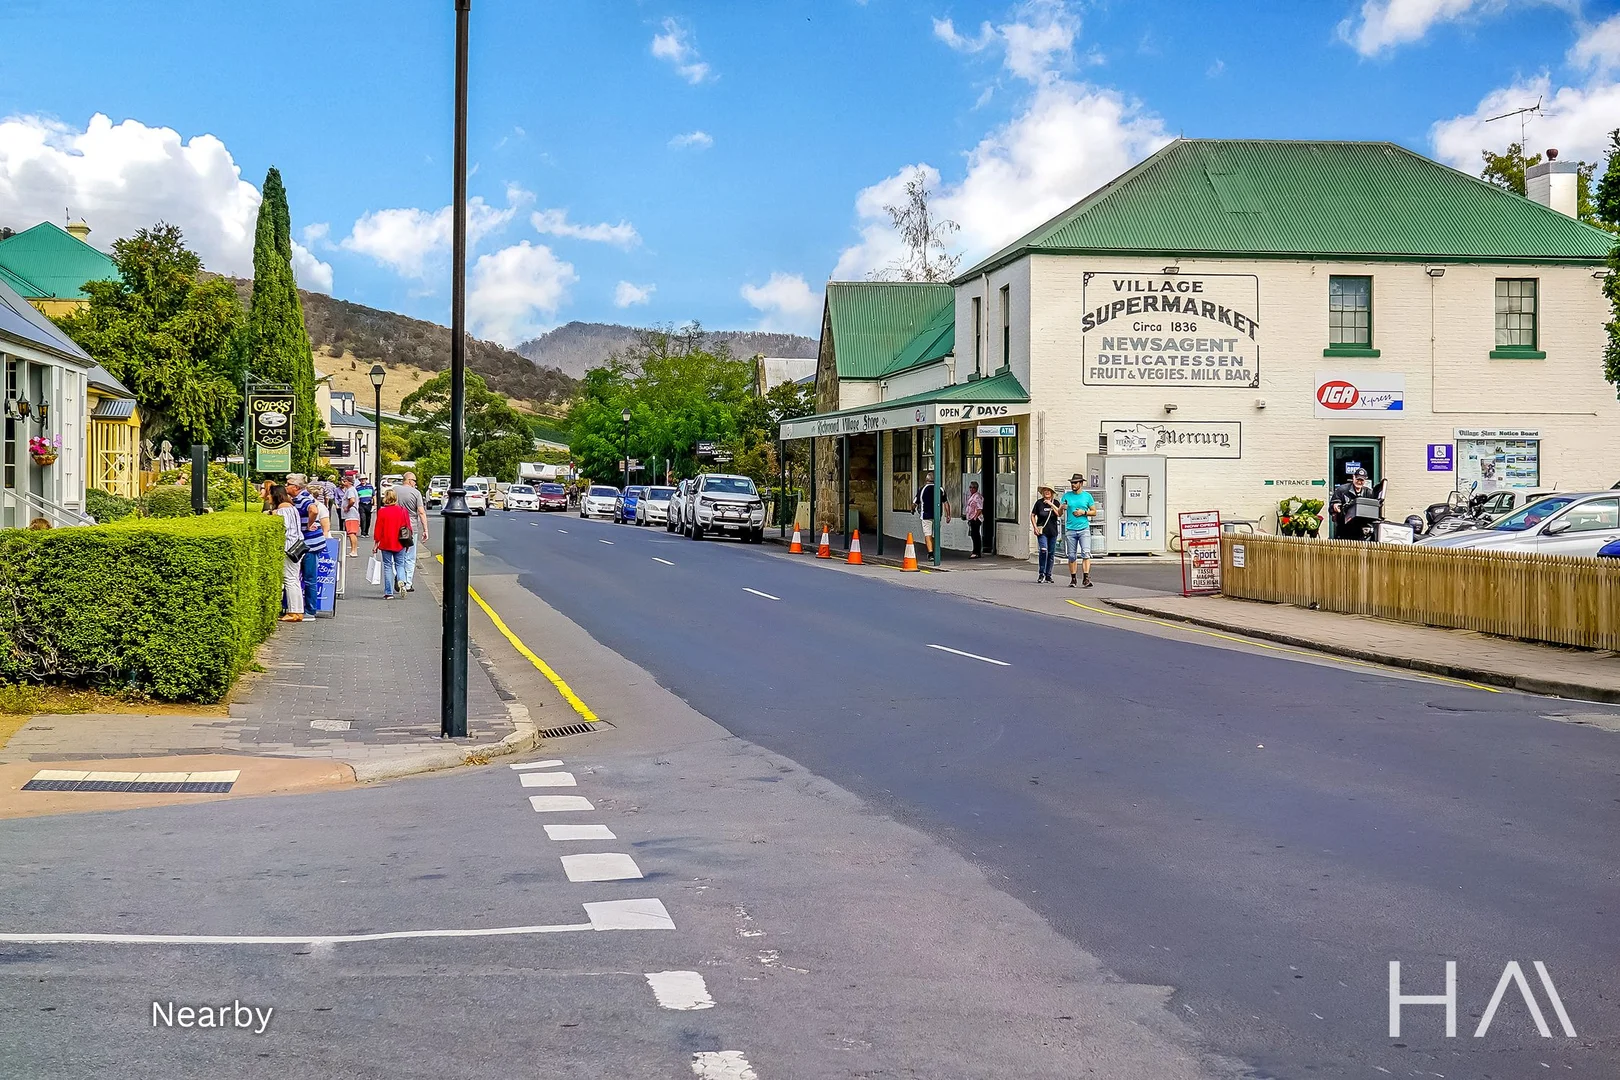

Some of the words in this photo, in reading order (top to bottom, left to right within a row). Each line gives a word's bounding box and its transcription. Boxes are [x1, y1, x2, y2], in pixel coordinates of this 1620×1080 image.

[1112, 280, 1204, 293] VILLAGE
[1082, 294, 1259, 341] SUPERMARKET
[1132, 321, 1162, 332] Circa
[1170, 322, 1198, 332] 1836
[1101, 337, 1239, 353] NEWSAGENT
[1097, 354, 1244, 367] DELICATESSEN
[1191, 368, 1221, 381] MILK
[1225, 369, 1252, 381] BAR
[1321, 386, 1356, 403] IGA
[940, 408, 960, 417] OPEN
[962, 405, 975, 419] 7
[977, 406, 1008, 415] DAYS
[863, 415, 879, 431] Store
[1155, 430, 1231, 449] Mercury
[1194, 549, 1217, 561] Sport
